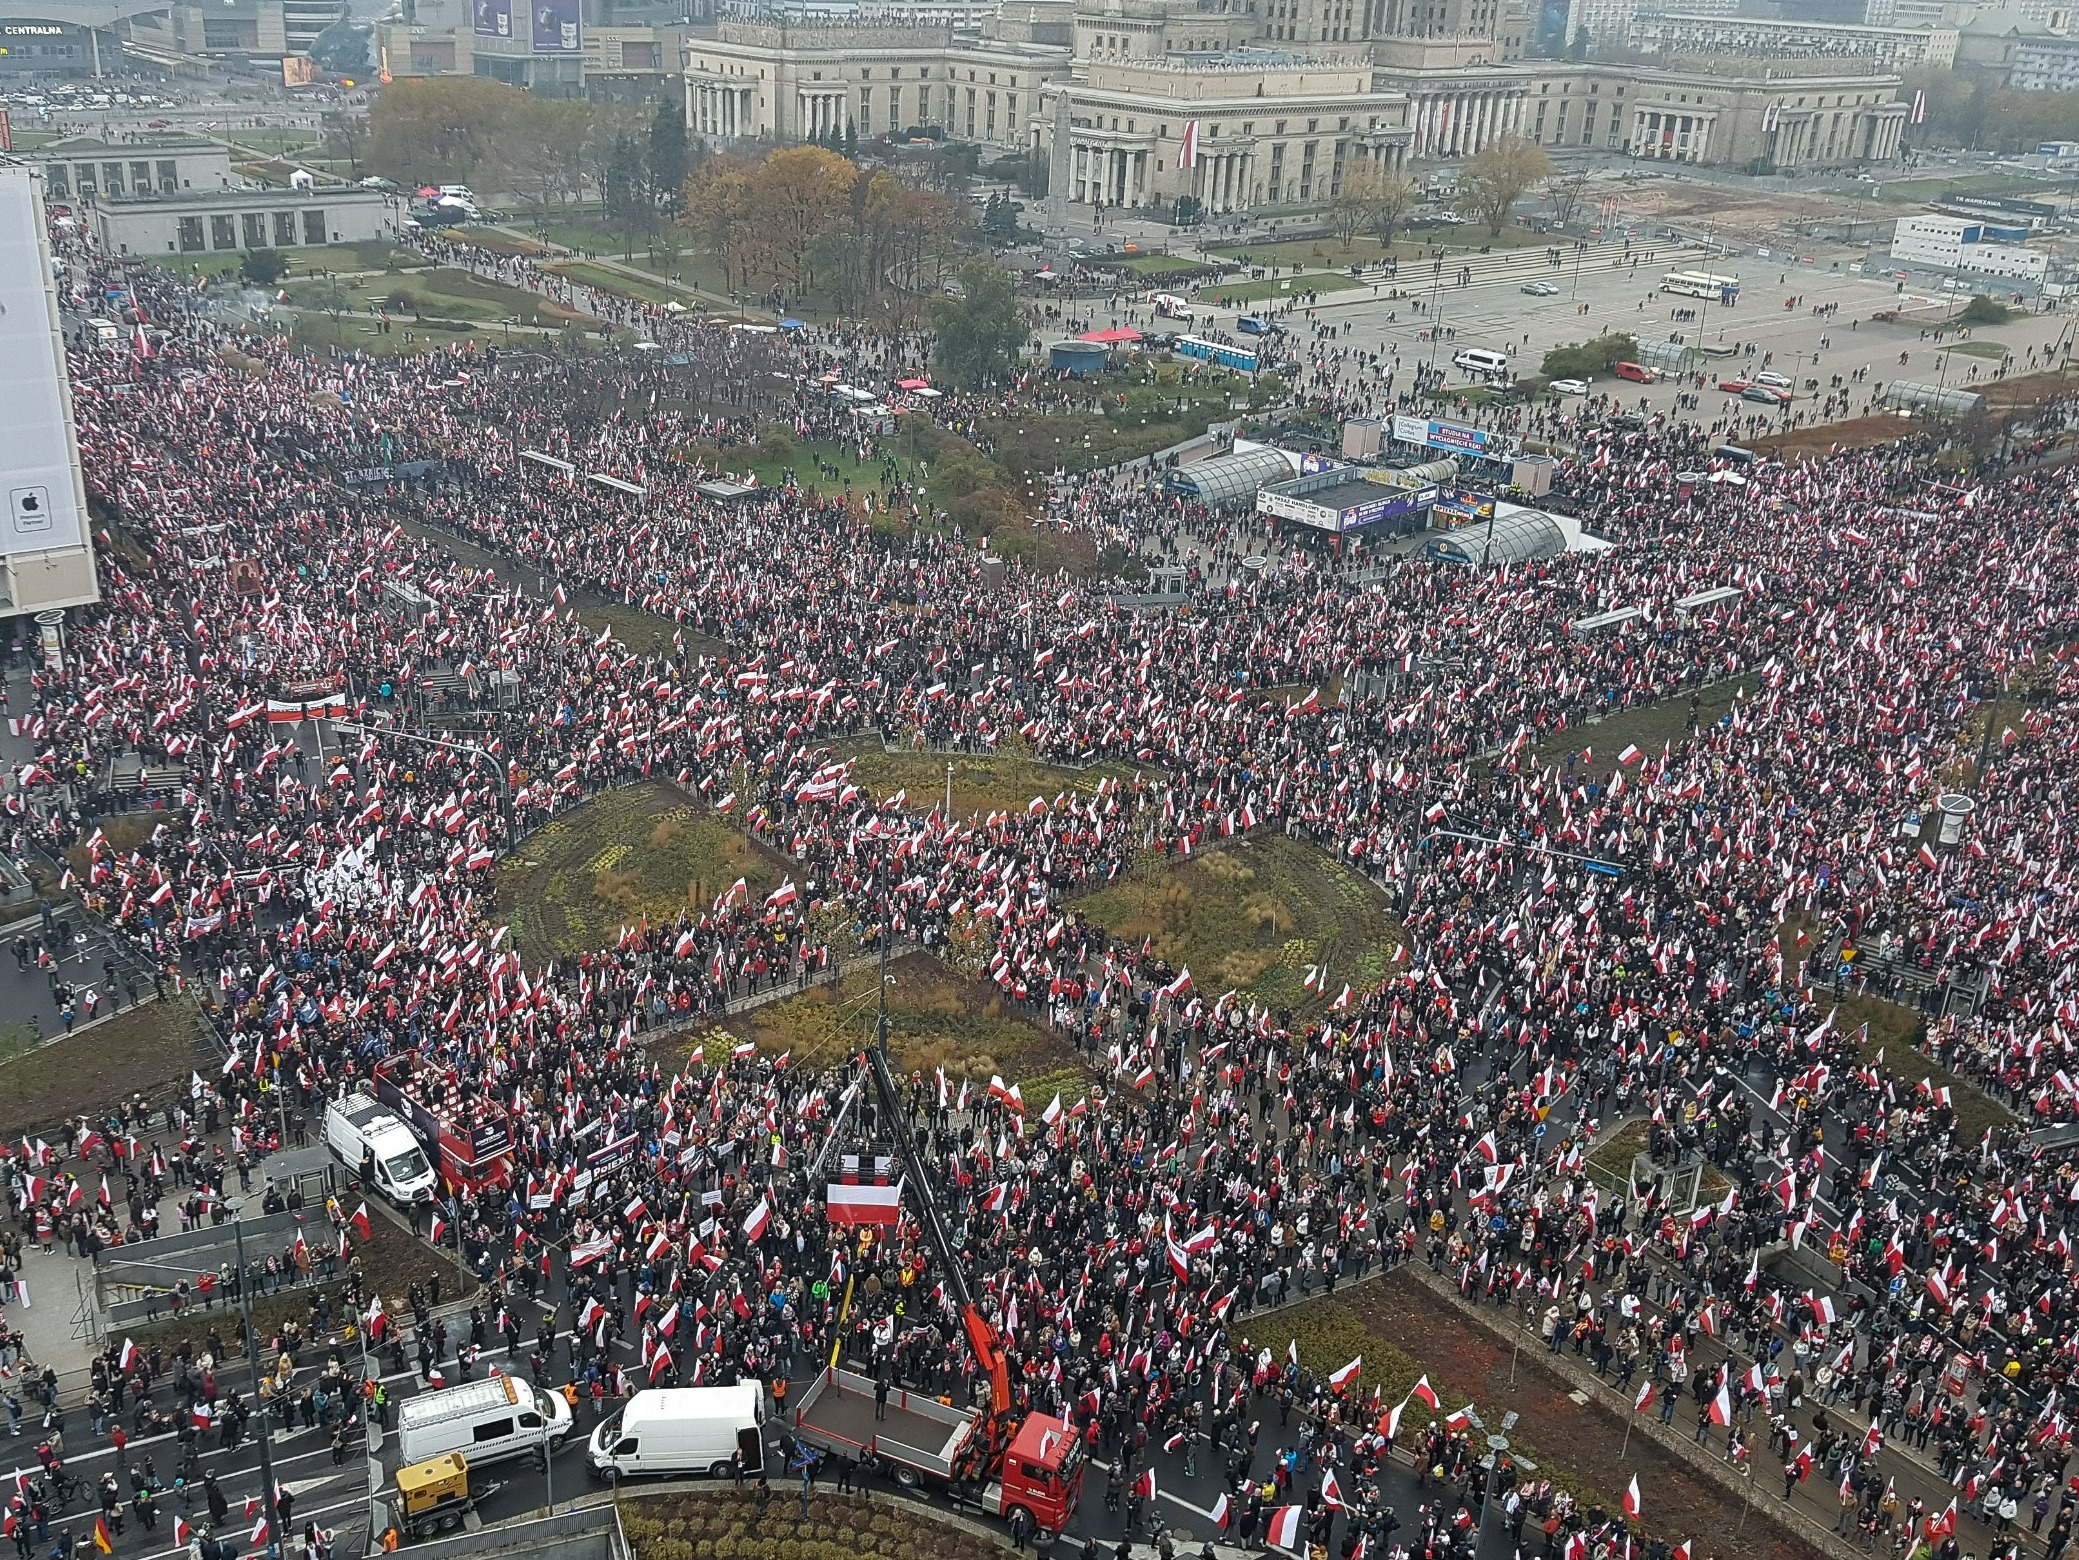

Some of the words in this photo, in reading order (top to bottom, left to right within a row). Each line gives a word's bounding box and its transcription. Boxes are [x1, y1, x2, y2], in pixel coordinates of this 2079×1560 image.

[5, 26, 63, 35] CENTRALNA
[1965, 197, 2001, 208] WARSZAWA
[1910, 813, 1917, 821] P
[593, 1150, 635, 1178] PolEXIT
